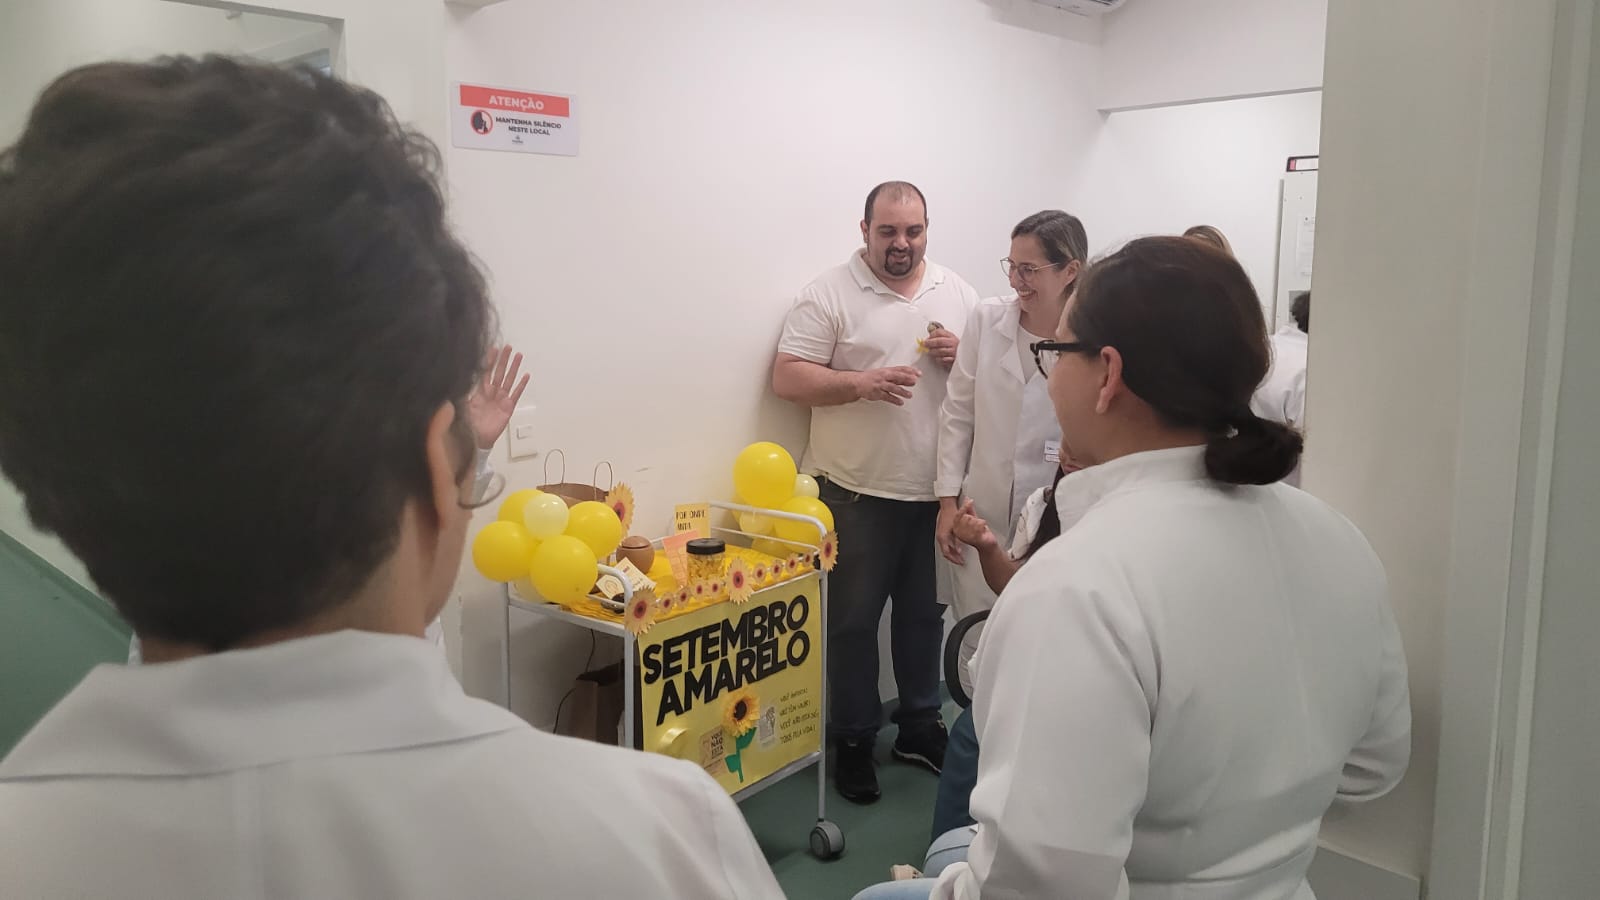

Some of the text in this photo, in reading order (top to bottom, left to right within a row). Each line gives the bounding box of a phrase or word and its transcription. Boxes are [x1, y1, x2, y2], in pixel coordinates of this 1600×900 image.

[489, 95, 545, 111] ATENÇÃO
[495, 116, 561, 129] MANTENHA SILÊNCIO
[508, 126, 529, 134] NESTE
[642, 594, 809, 685] SETEMBRO
[656, 630, 811, 727] AMARELO
[711, 737, 723, 748] NÃO
